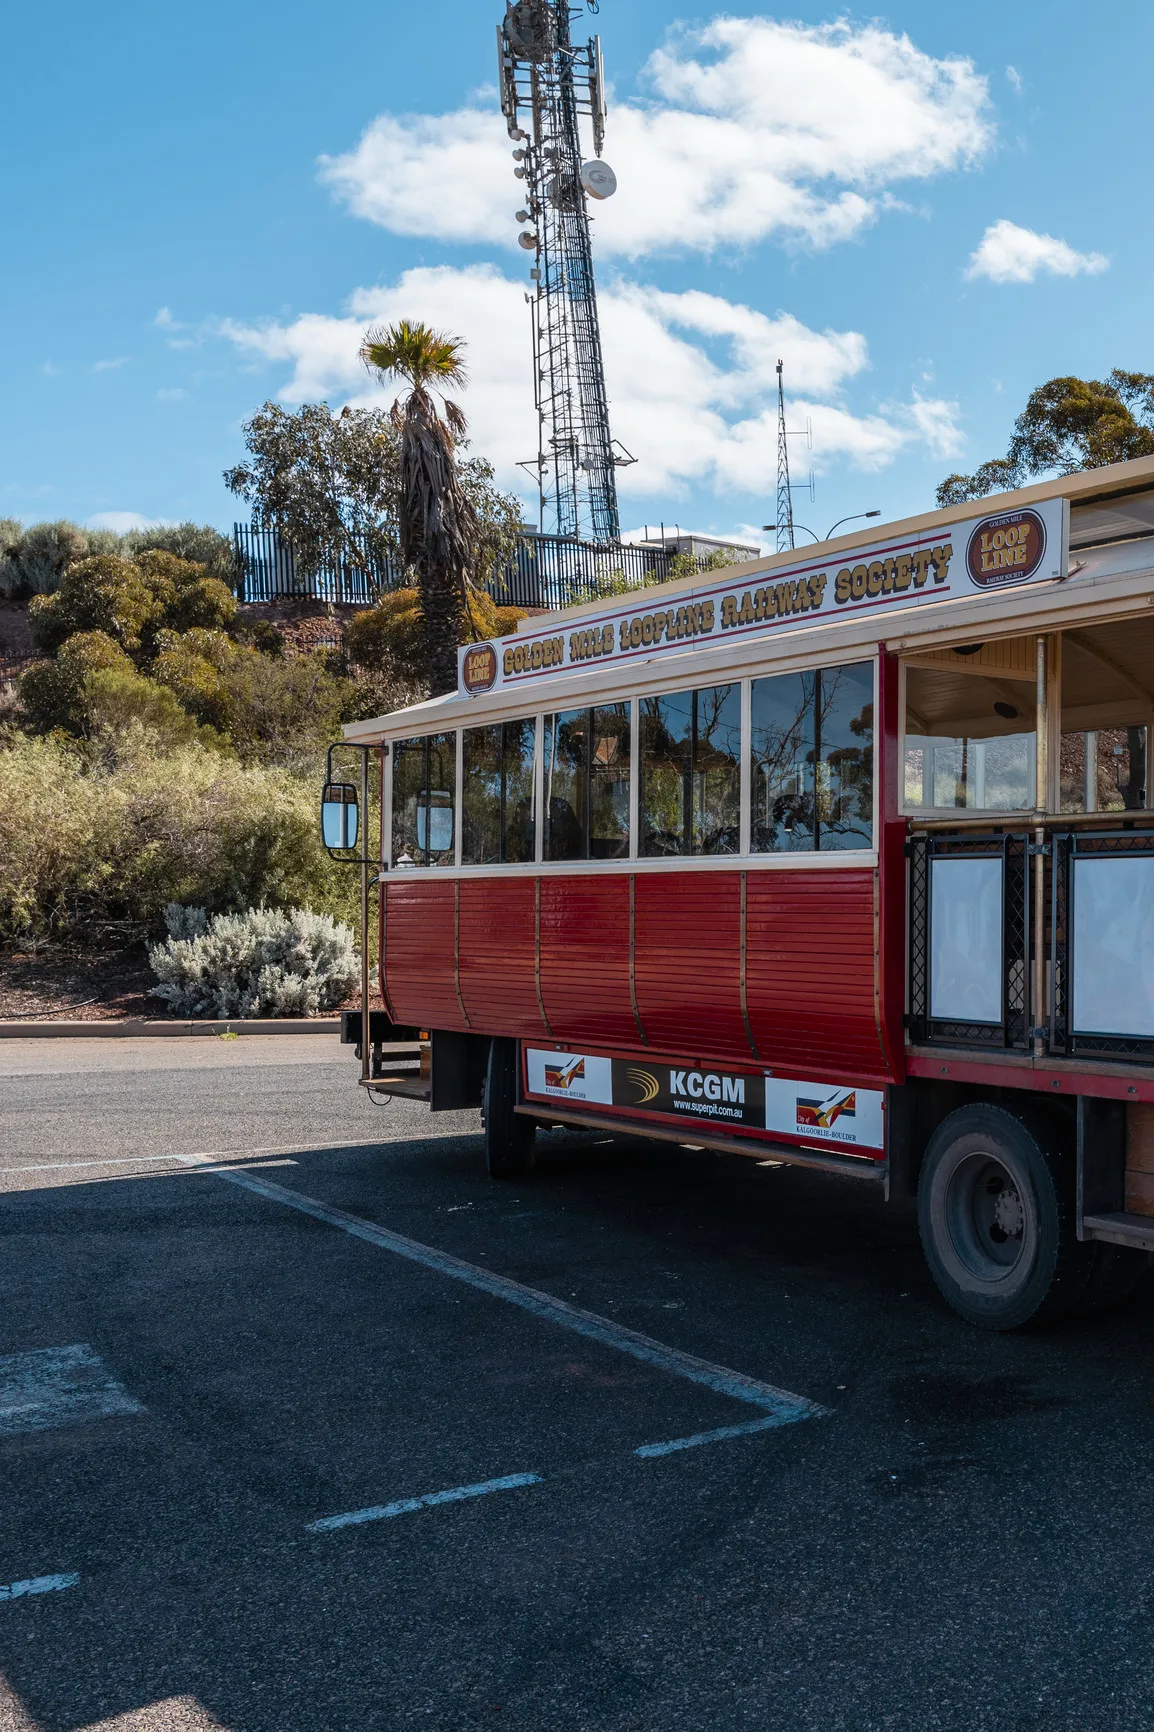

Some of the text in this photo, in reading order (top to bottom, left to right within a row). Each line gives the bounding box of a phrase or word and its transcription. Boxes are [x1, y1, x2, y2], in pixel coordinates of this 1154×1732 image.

[989, 515, 1023, 528] GOLDEN MILE
[981, 523, 1031, 553] LOOP
[981, 544, 1027, 572] LINE
[1004, 571, 1024, 581] SOCIETY
[503, 544, 953, 676] GOLDEN MILE LOOPLINE RAILWAY SOCIETY
[469, 652, 491, 670] LOOP
[469, 667, 490, 682] LINE
[669, 1070, 745, 1104] KCGM
[673, 1100, 743, 1118] www.superpit.com.au
[796, 1126, 857, 1142] KALGOORLIE-BOULDER
